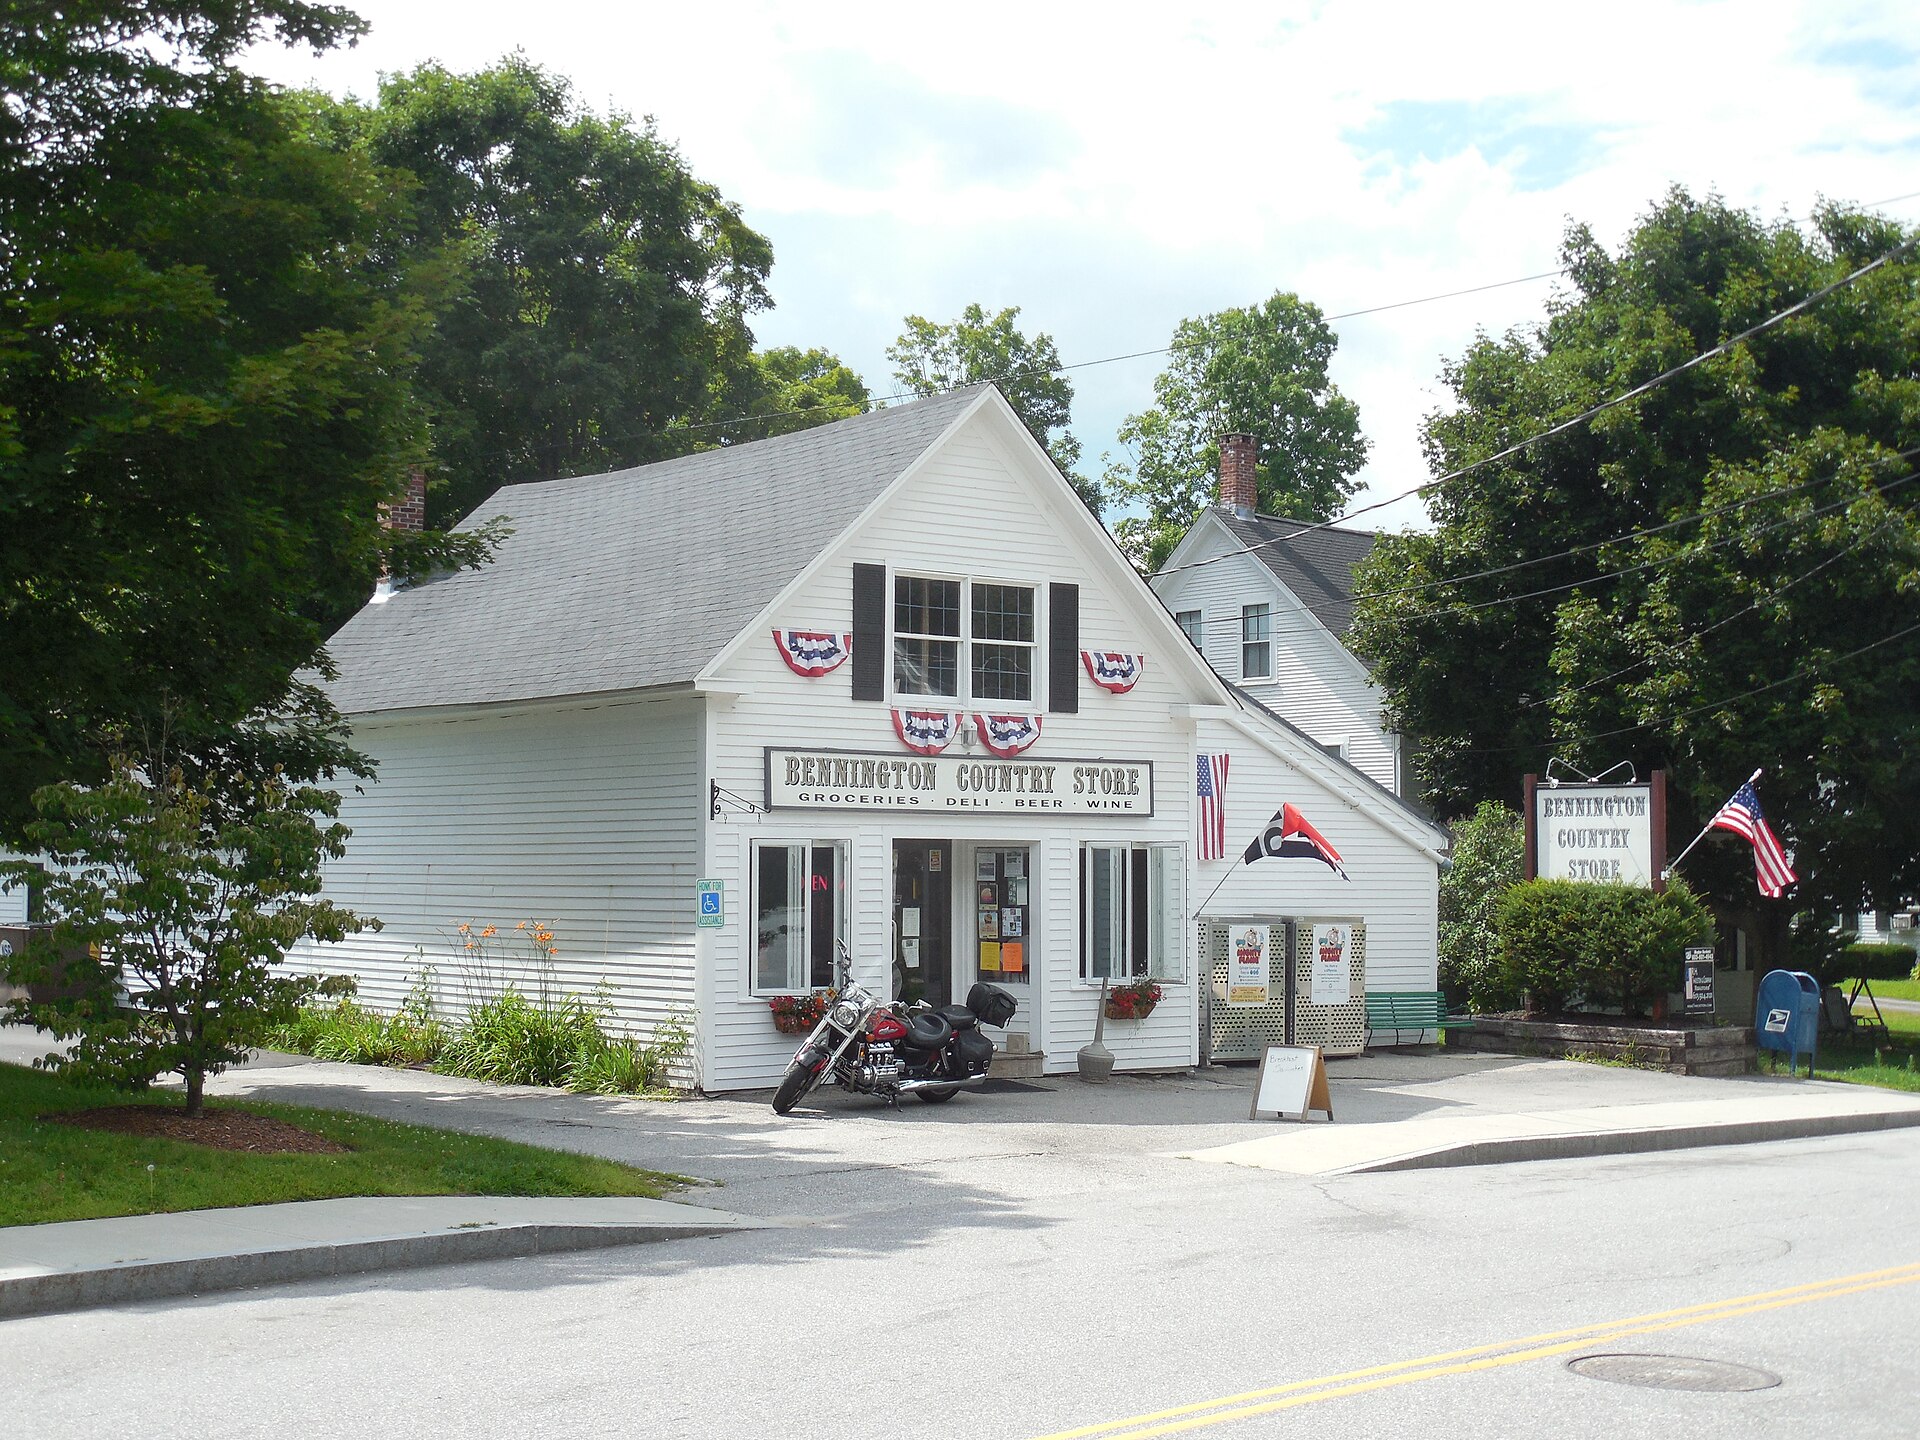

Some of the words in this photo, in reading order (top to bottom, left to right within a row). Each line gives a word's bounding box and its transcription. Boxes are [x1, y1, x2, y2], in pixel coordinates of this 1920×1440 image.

[784, 756, 937, 790] BENNINGTON
[956, 763, 1056, 794] COUNTRY
[1073, 766, 1140, 796] STORE
[798, 792, 920, 805] GROCERIES
[946, 797, 990, 807] DELI
[1015, 799, 1064, 808] BEER
[1086, 800, 1133, 809] WINE
[1543, 796, 1646, 818] BENNINGTON
[1558, 828, 1631, 849] COUNTRY
[1568, 859, 1621, 880] STORE
[699, 881, 712, 891] HONK
[712, 881, 722, 891] FOR
[699, 915, 723, 926] ASSISTANCE
